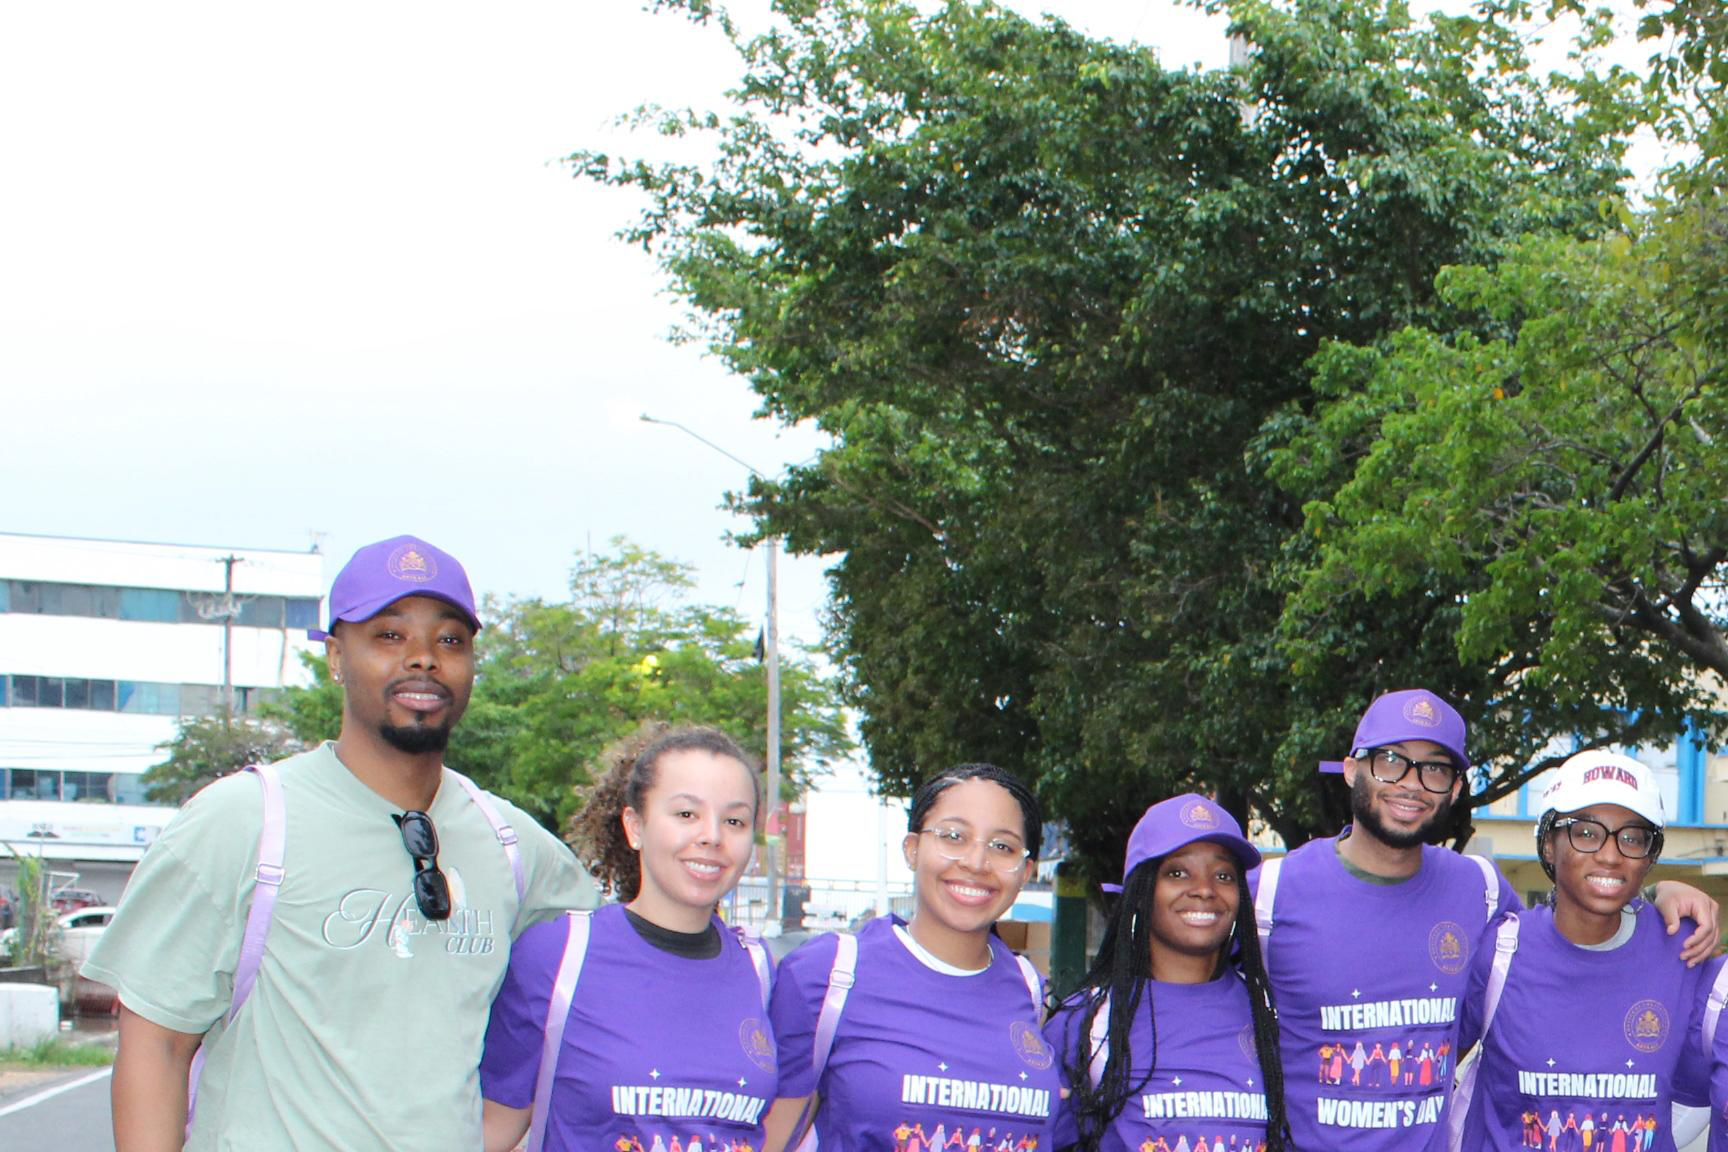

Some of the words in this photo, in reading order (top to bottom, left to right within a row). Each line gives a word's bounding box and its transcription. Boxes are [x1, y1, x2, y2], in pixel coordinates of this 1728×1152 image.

[1583, 766, 1638, 791] HOWARD
[445, 937, 496, 955] CLUB
[1320, 997, 1456, 1031] INTERNATIONAL
[902, 1075, 1050, 1117] INTERNATIONAL
[1518, 1071, 1657, 1098] INTERNATIONAL
[612, 1085, 766, 1125] INTERNATIONAL
[1143, 1091, 1269, 1120] INTERNATIONA
[1317, 1097, 1416, 1128] WOMEN'S
